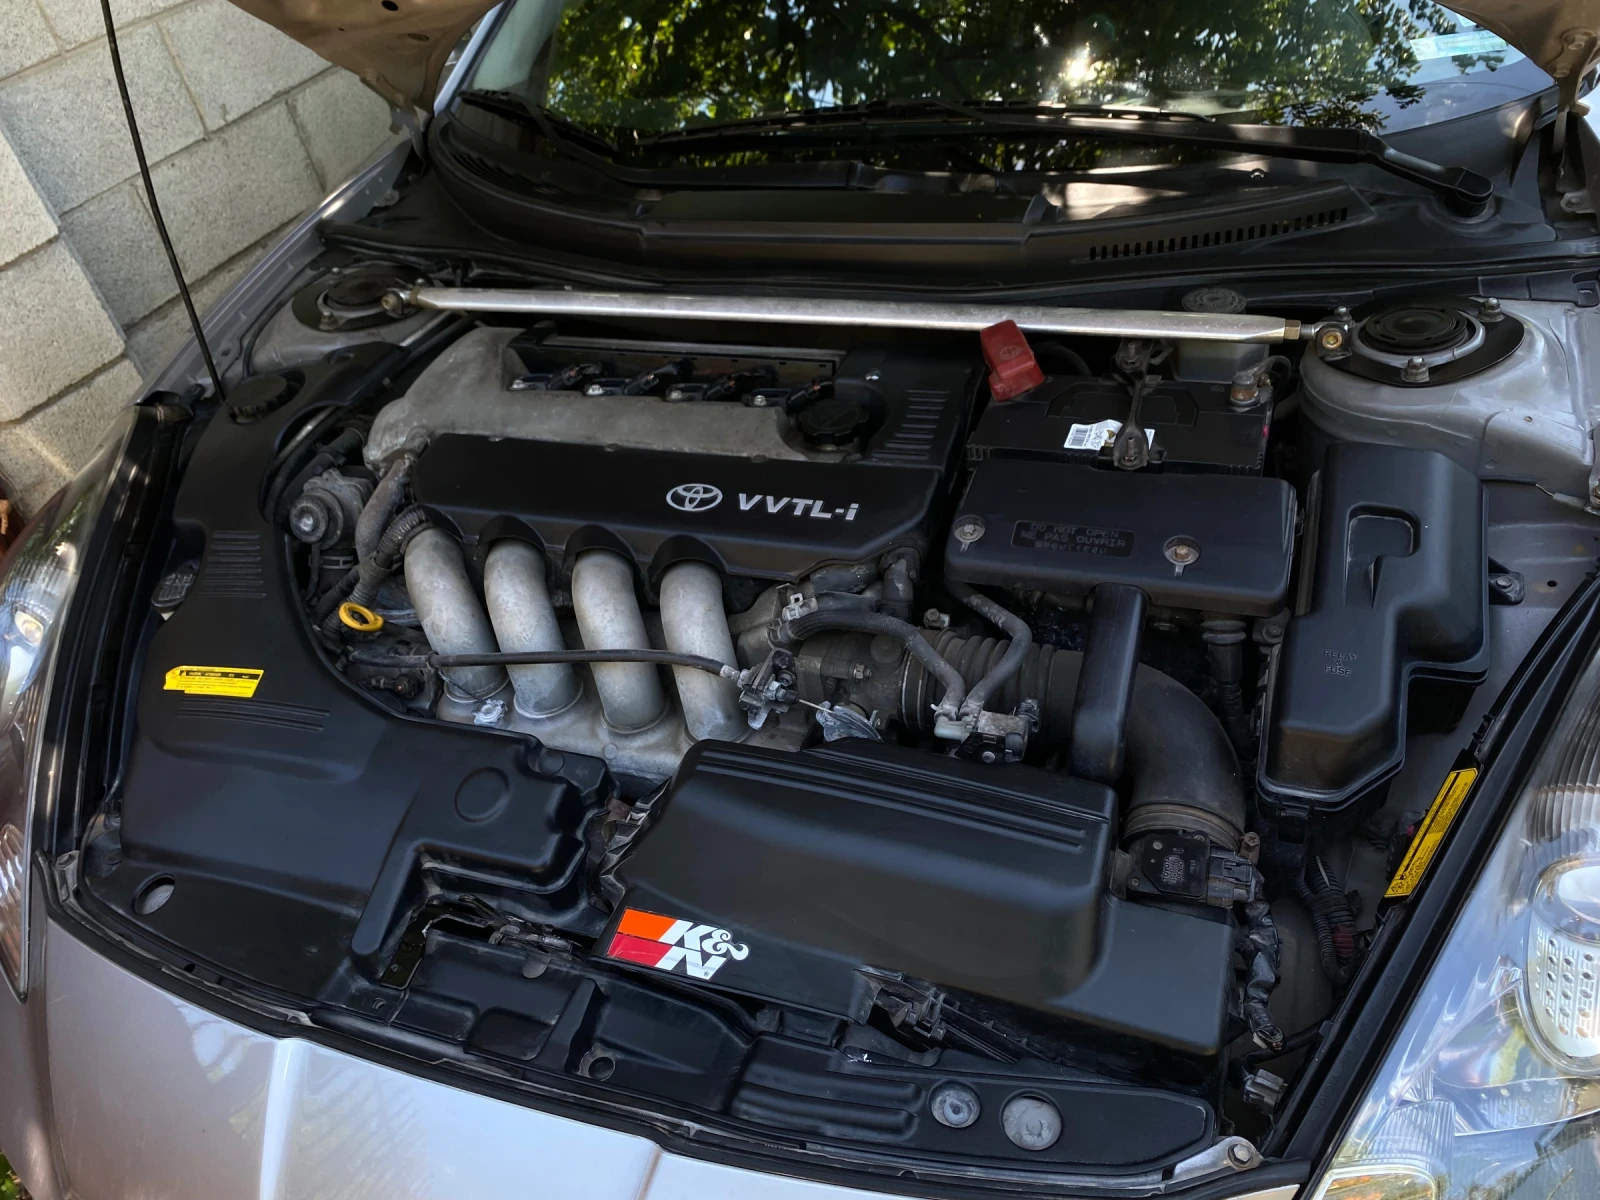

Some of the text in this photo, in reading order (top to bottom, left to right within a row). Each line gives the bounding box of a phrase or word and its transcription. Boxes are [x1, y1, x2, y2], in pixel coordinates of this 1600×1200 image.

[738, 493, 860, 521] VVTL-i
[1054, 526, 1077, 535] NOT
[1086, 528, 1119, 538] OPEN
[1323, 650, 1358, 661] RELAY
[1324, 665, 1352, 676] FUSE
